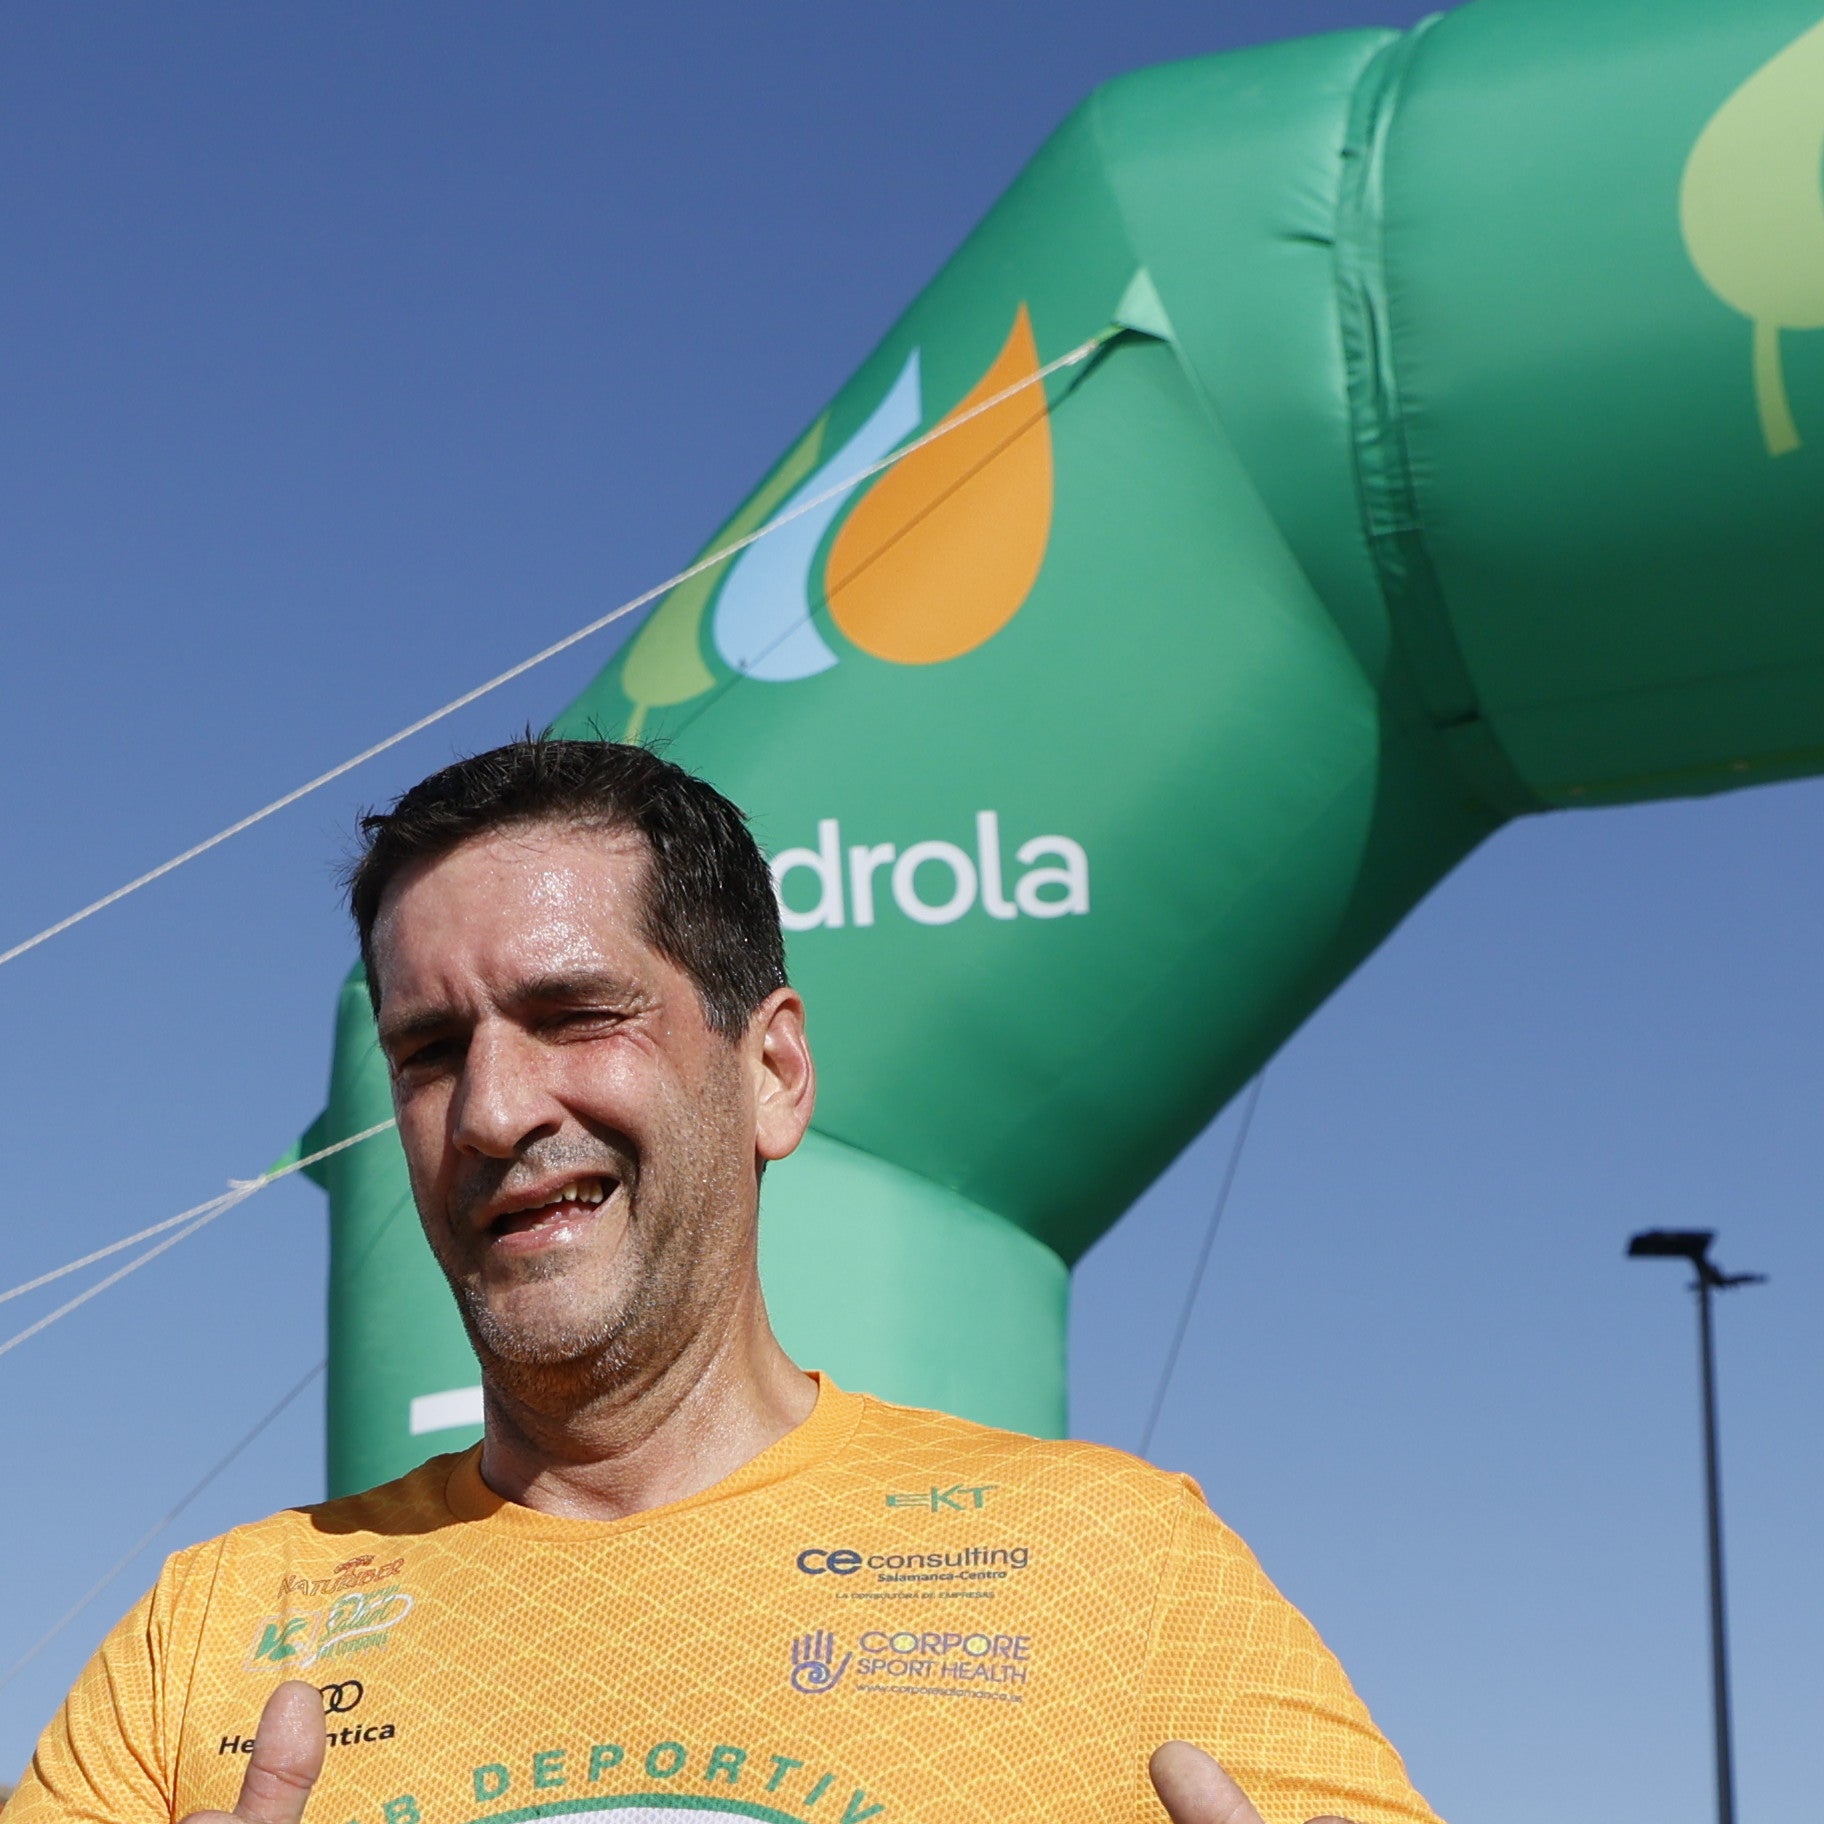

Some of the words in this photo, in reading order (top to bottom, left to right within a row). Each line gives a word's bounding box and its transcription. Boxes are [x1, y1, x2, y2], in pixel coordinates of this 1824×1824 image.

[773, 811, 1090, 931] drola
[796, 1549, 863, 1576] ce
[867, 1547, 1028, 1569] consulting
[877, 1571, 1007, 1583] Salamanca-Centro
[859, 1631, 1031, 1661] CORPORE
[857, 1658, 935, 1677] SPORT
[941, 1660, 1026, 1684] HEALTH
[219, 1723, 395, 1755] Hentica
